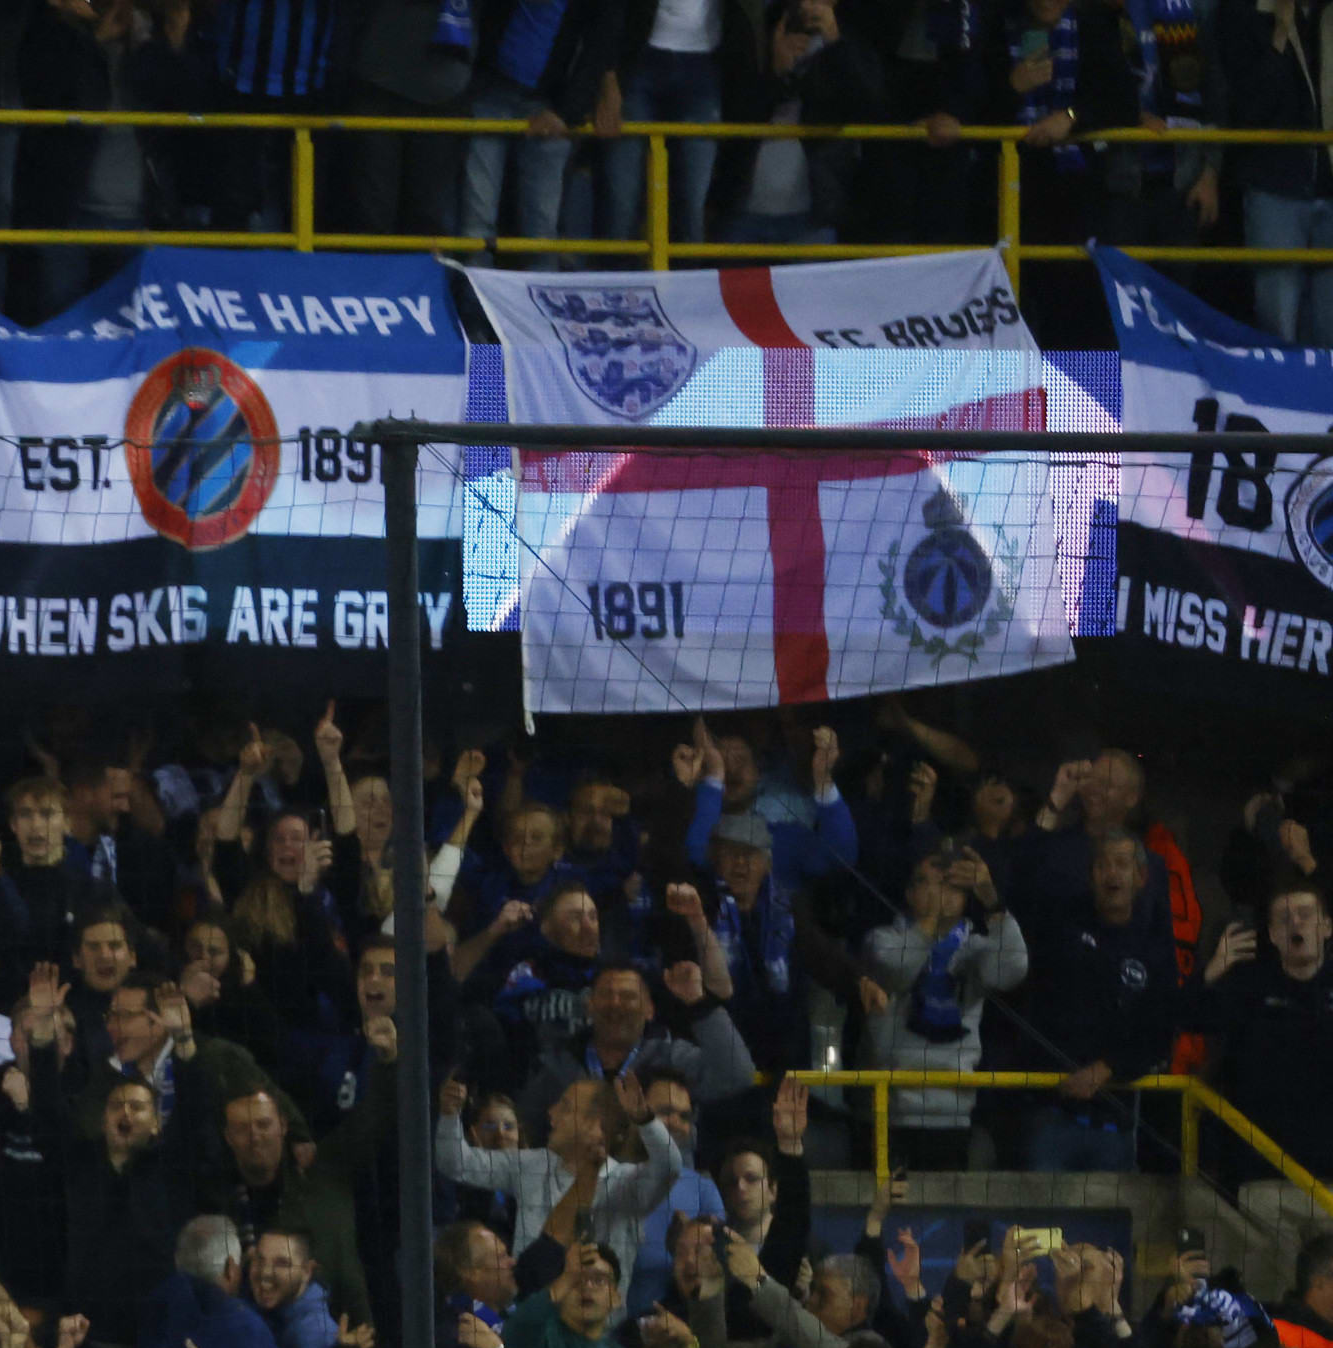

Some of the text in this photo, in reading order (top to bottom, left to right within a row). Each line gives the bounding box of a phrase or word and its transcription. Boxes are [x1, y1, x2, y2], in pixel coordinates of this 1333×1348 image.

[176, 281, 256, 333] ME
[260, 291, 435, 336] HAPPY
[19, 427, 386, 492] EST. 189
[107, 585, 208, 651] SKIS
[226, 590, 318, 648] ARE
[334, 591, 451, 650] GRY
[586, 581, 684, 641] 1891
[1144, 581, 1227, 654] MISS
